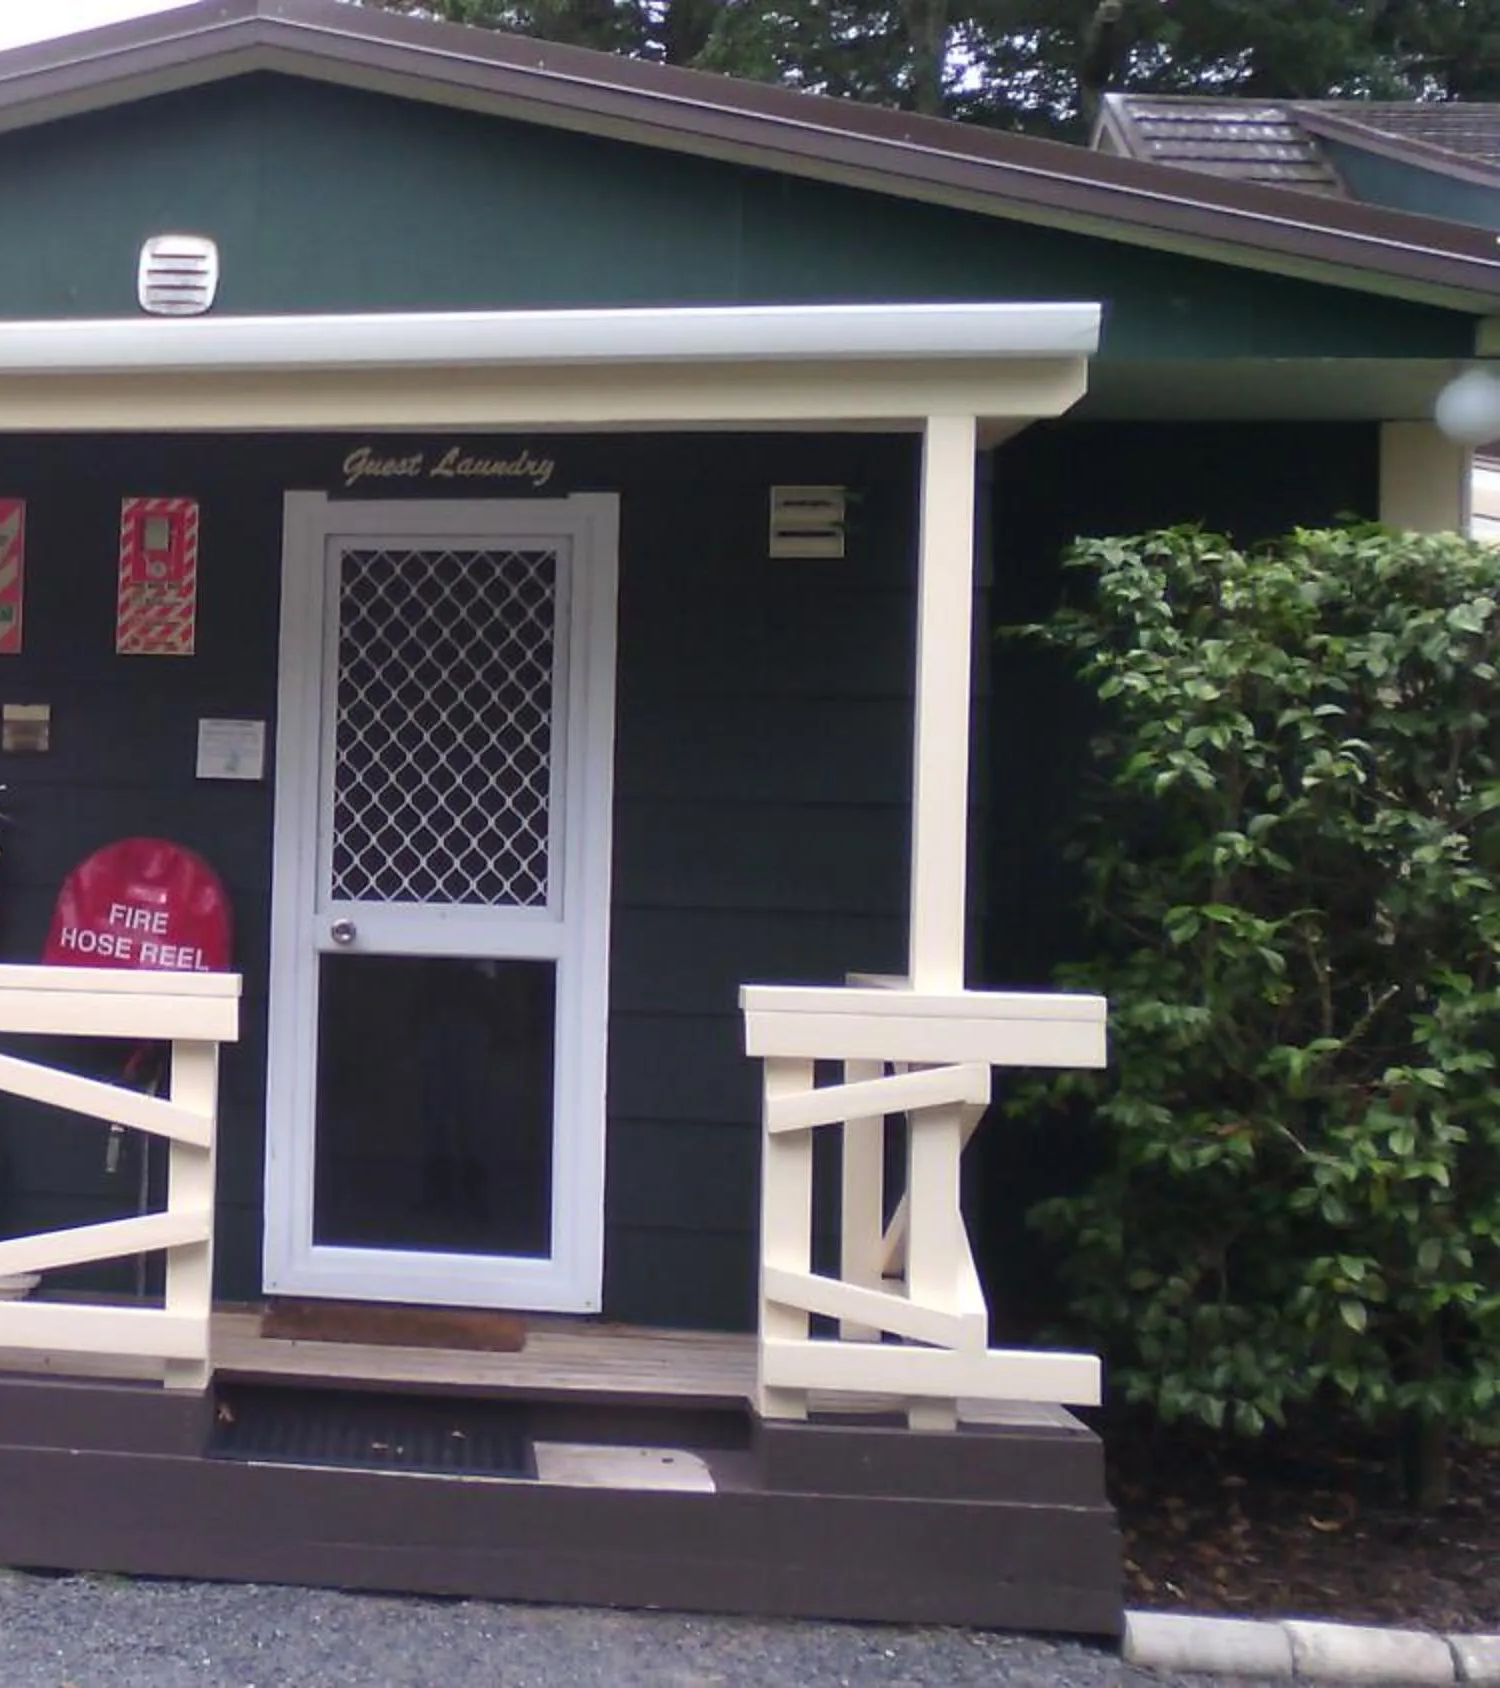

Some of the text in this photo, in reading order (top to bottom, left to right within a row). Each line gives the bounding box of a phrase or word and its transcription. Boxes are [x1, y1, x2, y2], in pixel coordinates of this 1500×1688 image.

[342, 446, 556, 487] Guest Laundry
[109, 903, 169, 934] FIRE
[60, 927, 209, 972] HOSE REEL
